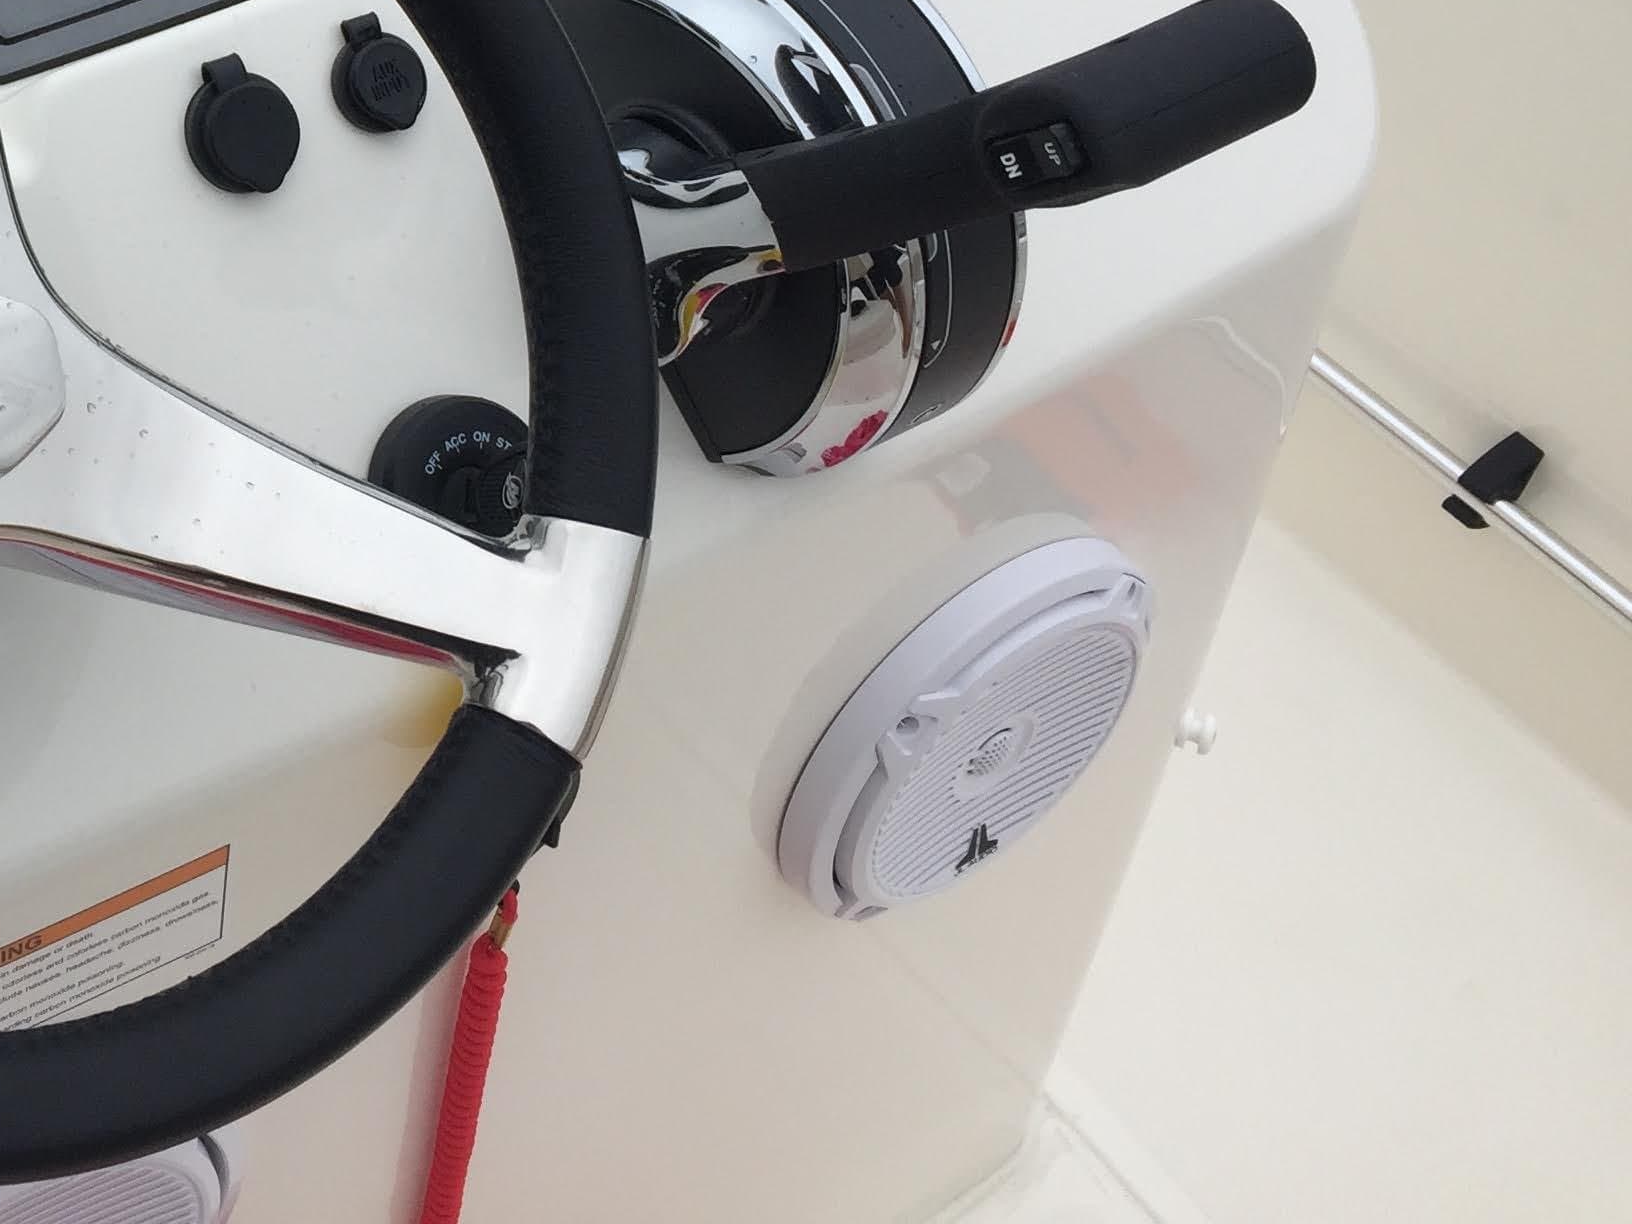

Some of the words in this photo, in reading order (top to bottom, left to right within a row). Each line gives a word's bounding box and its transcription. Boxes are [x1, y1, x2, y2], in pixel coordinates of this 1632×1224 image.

[1000, 152, 1023, 179] DN
[1044, 142, 1062, 166] UP
[424, 450, 442, 475] OFF
[444, 433, 467, 452] ACC
[473, 431, 491, 443] ON
[495, 436, 512, 451] ST
[46, 957, 64, 970] and
[111, 922, 142, 940] carbon
[12, 952, 51, 973] damage
